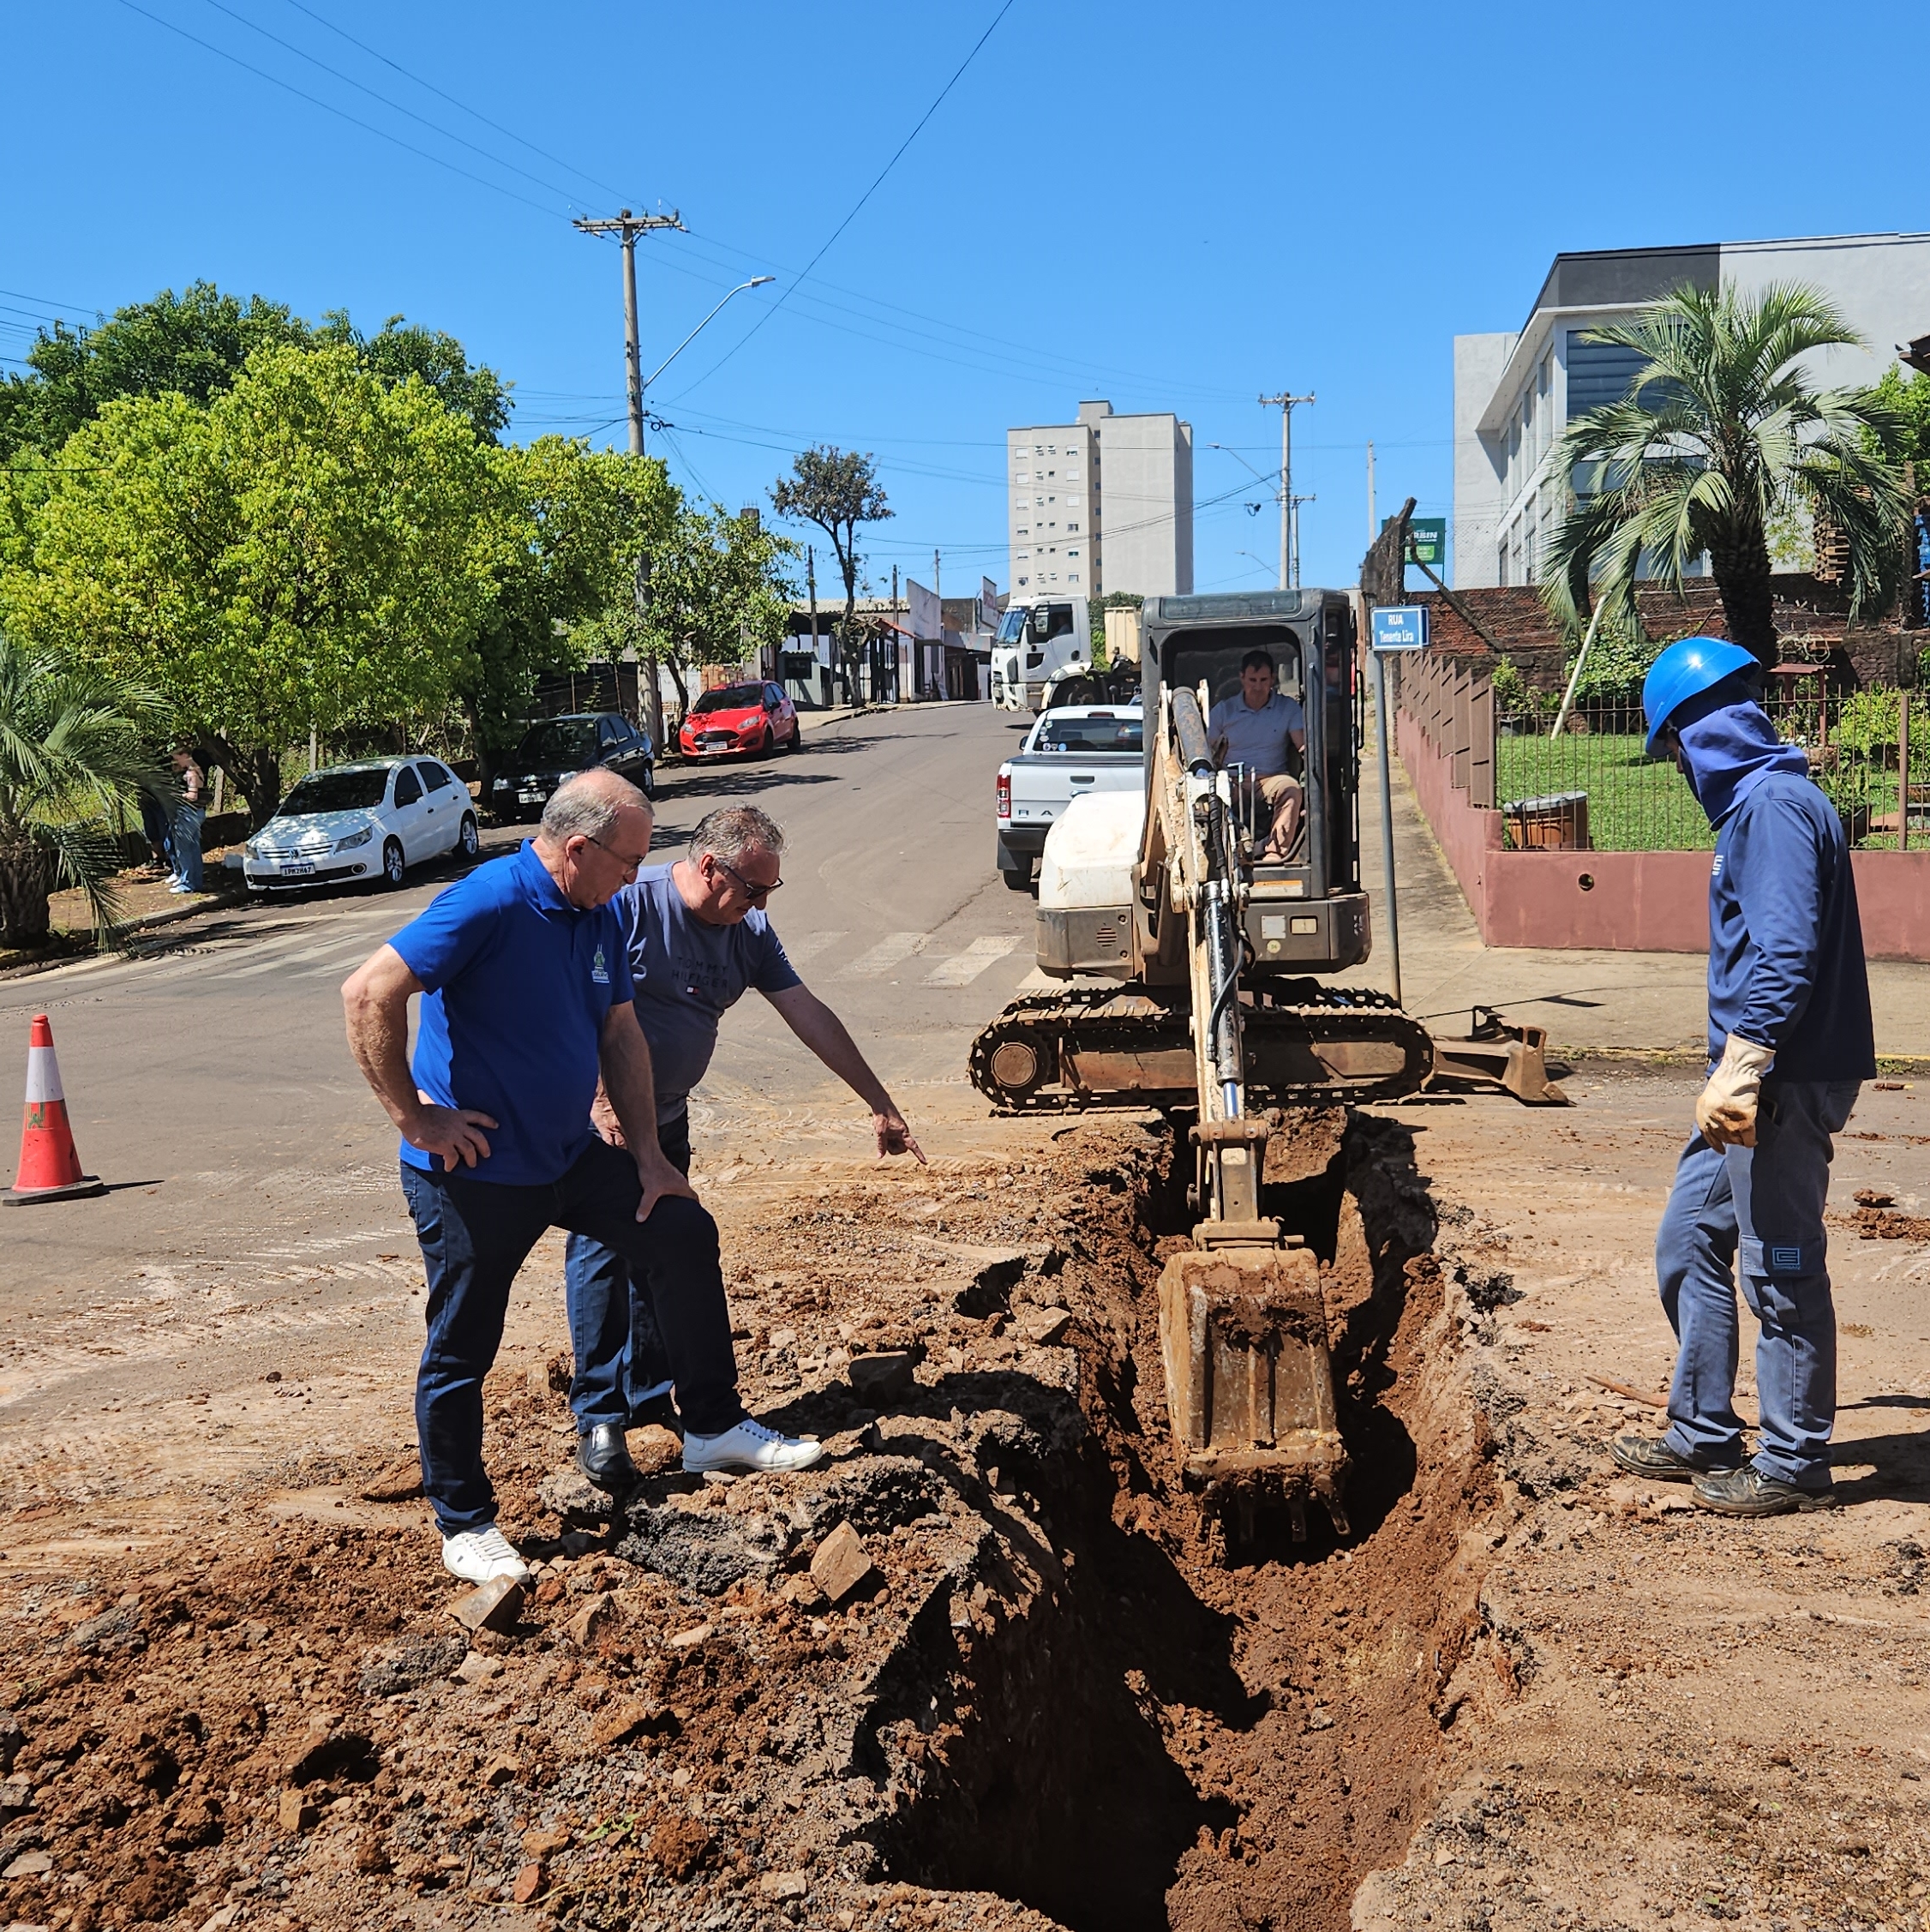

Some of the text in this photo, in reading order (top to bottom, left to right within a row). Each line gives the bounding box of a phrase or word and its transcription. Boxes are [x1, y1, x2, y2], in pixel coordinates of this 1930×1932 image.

[1388, 614, 1404, 625] RUA
[1401, 629, 1414, 642] Lira
[677, 957, 728, 975] TOMMY
[671, 969, 728, 988] HILFIGER
